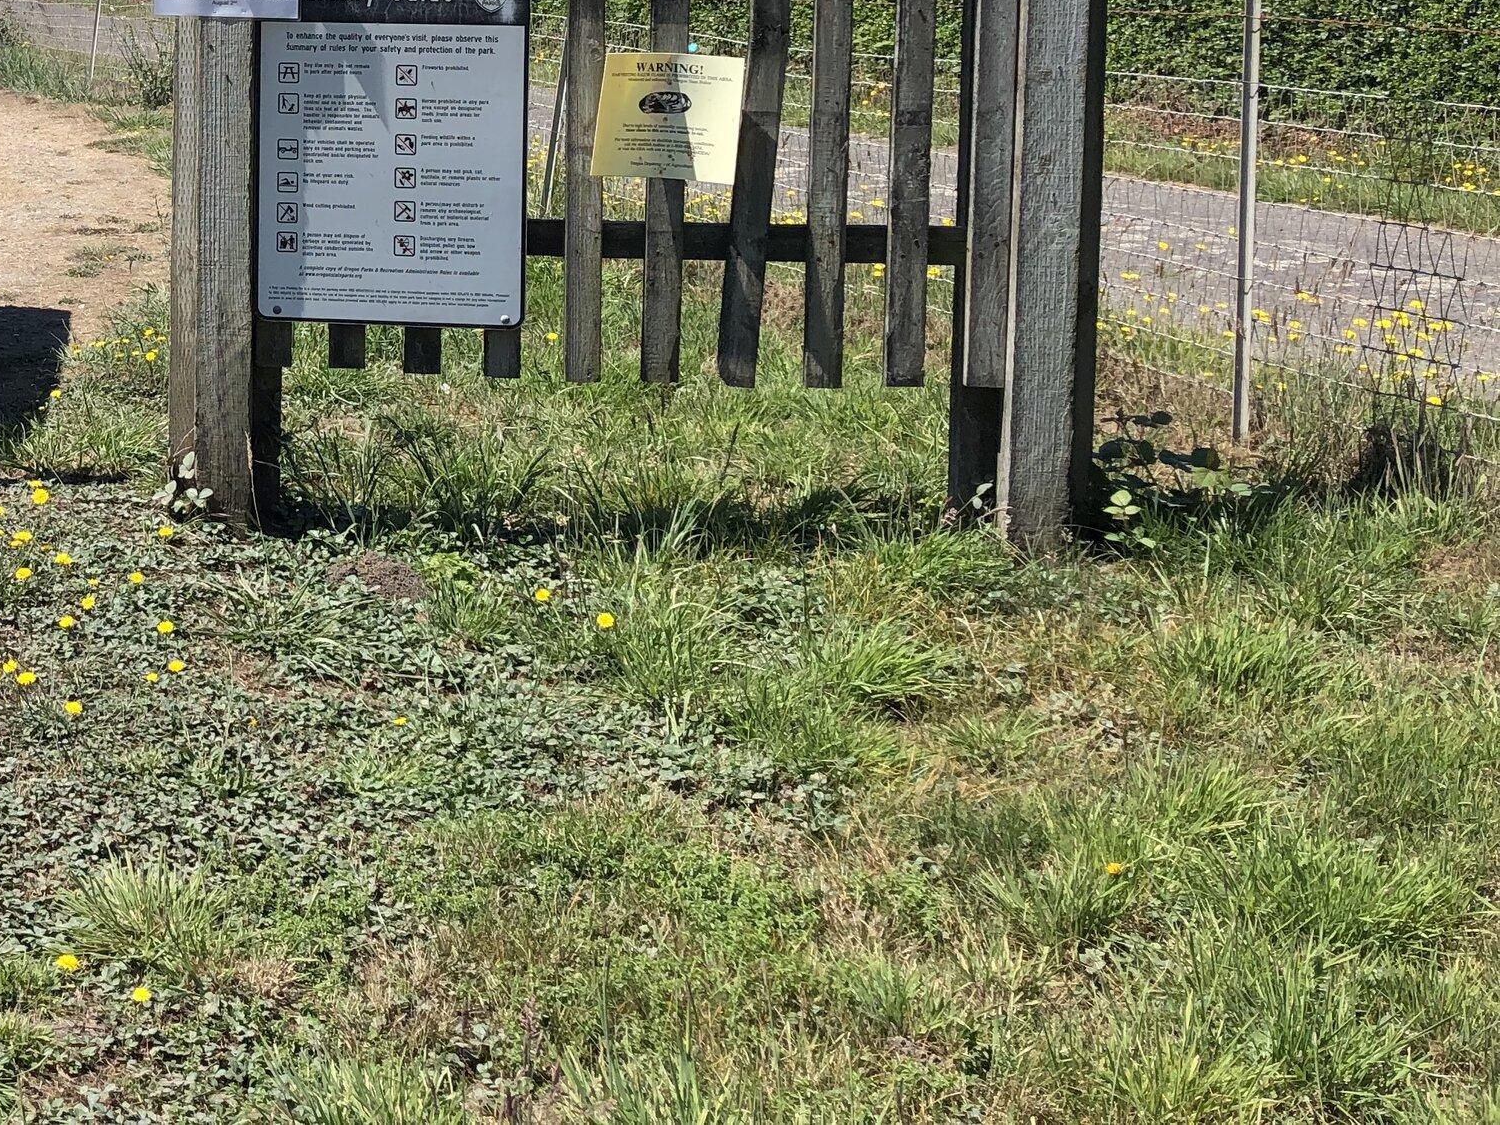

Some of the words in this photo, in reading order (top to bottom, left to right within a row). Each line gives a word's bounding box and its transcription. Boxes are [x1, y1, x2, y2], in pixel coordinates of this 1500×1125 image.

[339, 33, 362, 42] quality
[375, 34, 410, 42] everyone's
[412, 34, 428, 42] visit,
[431, 35, 452, 43] please
[286, 44, 316, 53] Summary
[362, 46, 377, 54] your
[380, 46, 401, 54] safety
[418, 46, 452, 55] protection
[478, 47, 495, 56] park.
[637, 63, 704, 74] WARNING!
